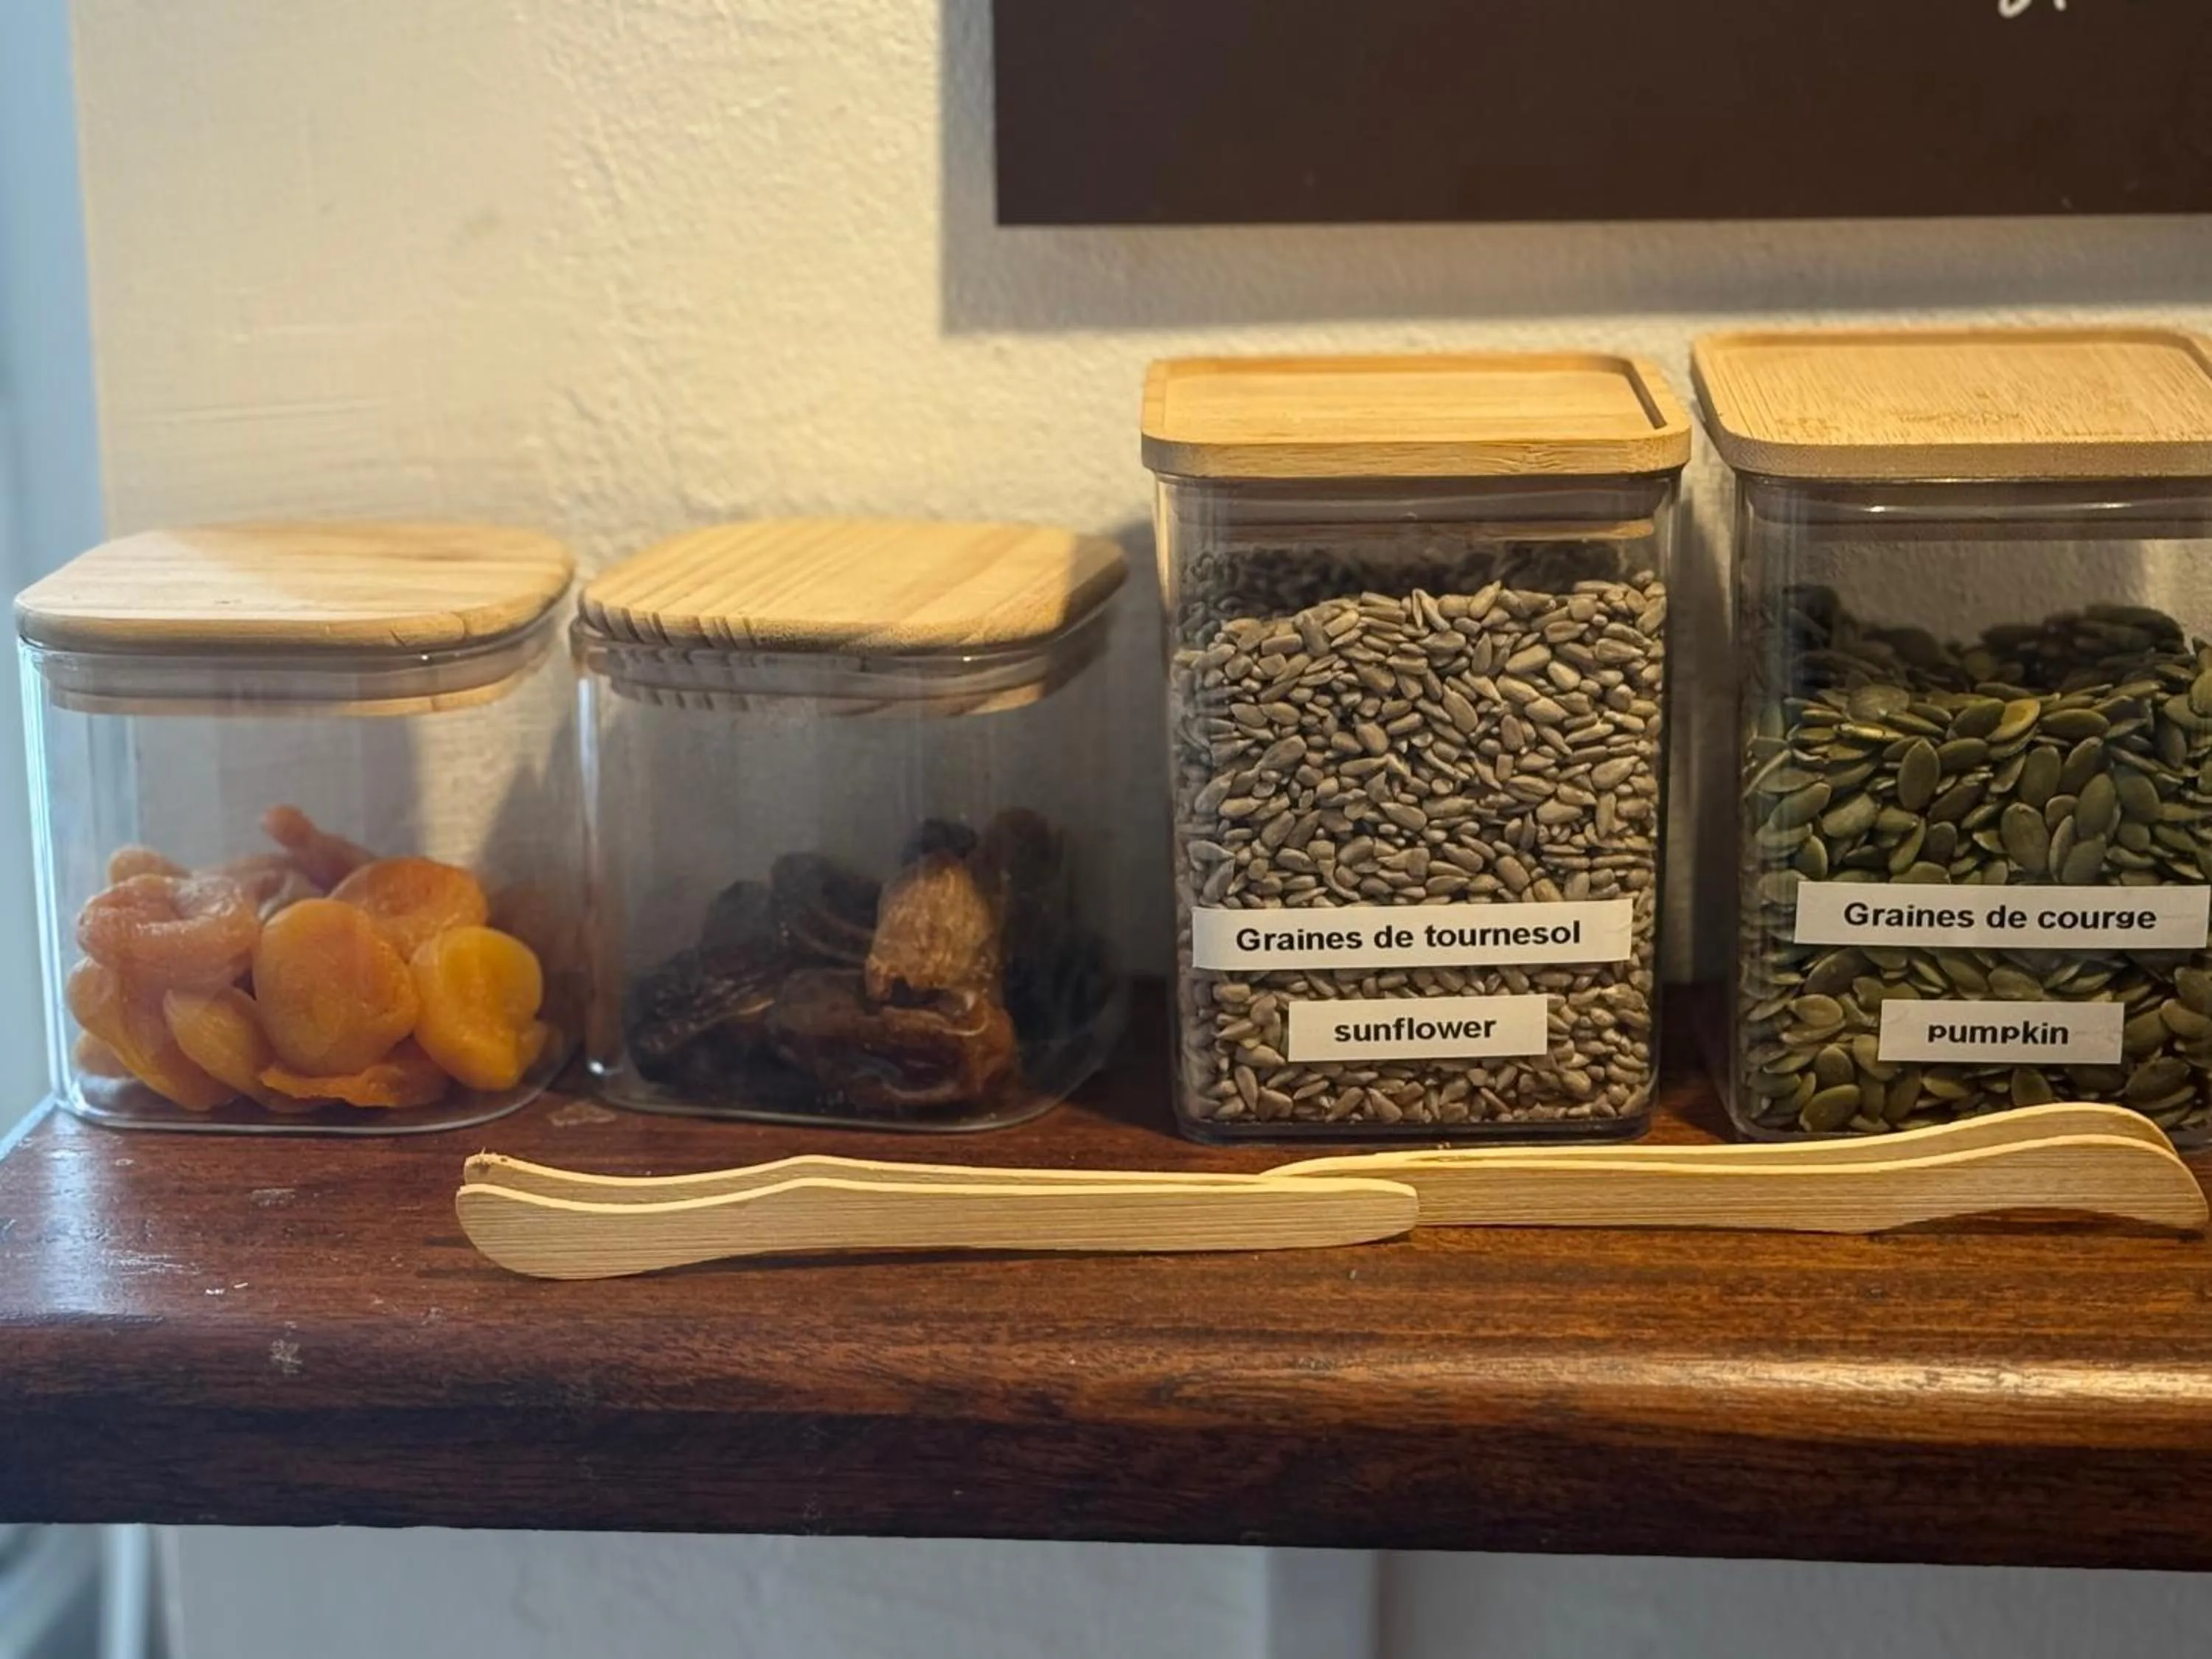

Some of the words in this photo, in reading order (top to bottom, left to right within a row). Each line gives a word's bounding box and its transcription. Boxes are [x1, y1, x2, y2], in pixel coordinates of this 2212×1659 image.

[1843, 901, 1975, 929] Graines
[1985, 903, 2028, 930] de
[2037, 910, 2157, 931] courge
[1236, 927, 1363, 952] Graines
[1373, 924, 1414, 950] de
[1424, 919, 1581, 948] tournesol
[1334, 1016, 1498, 1043] sunflower
[1927, 1019, 2070, 1046] pumpkin
